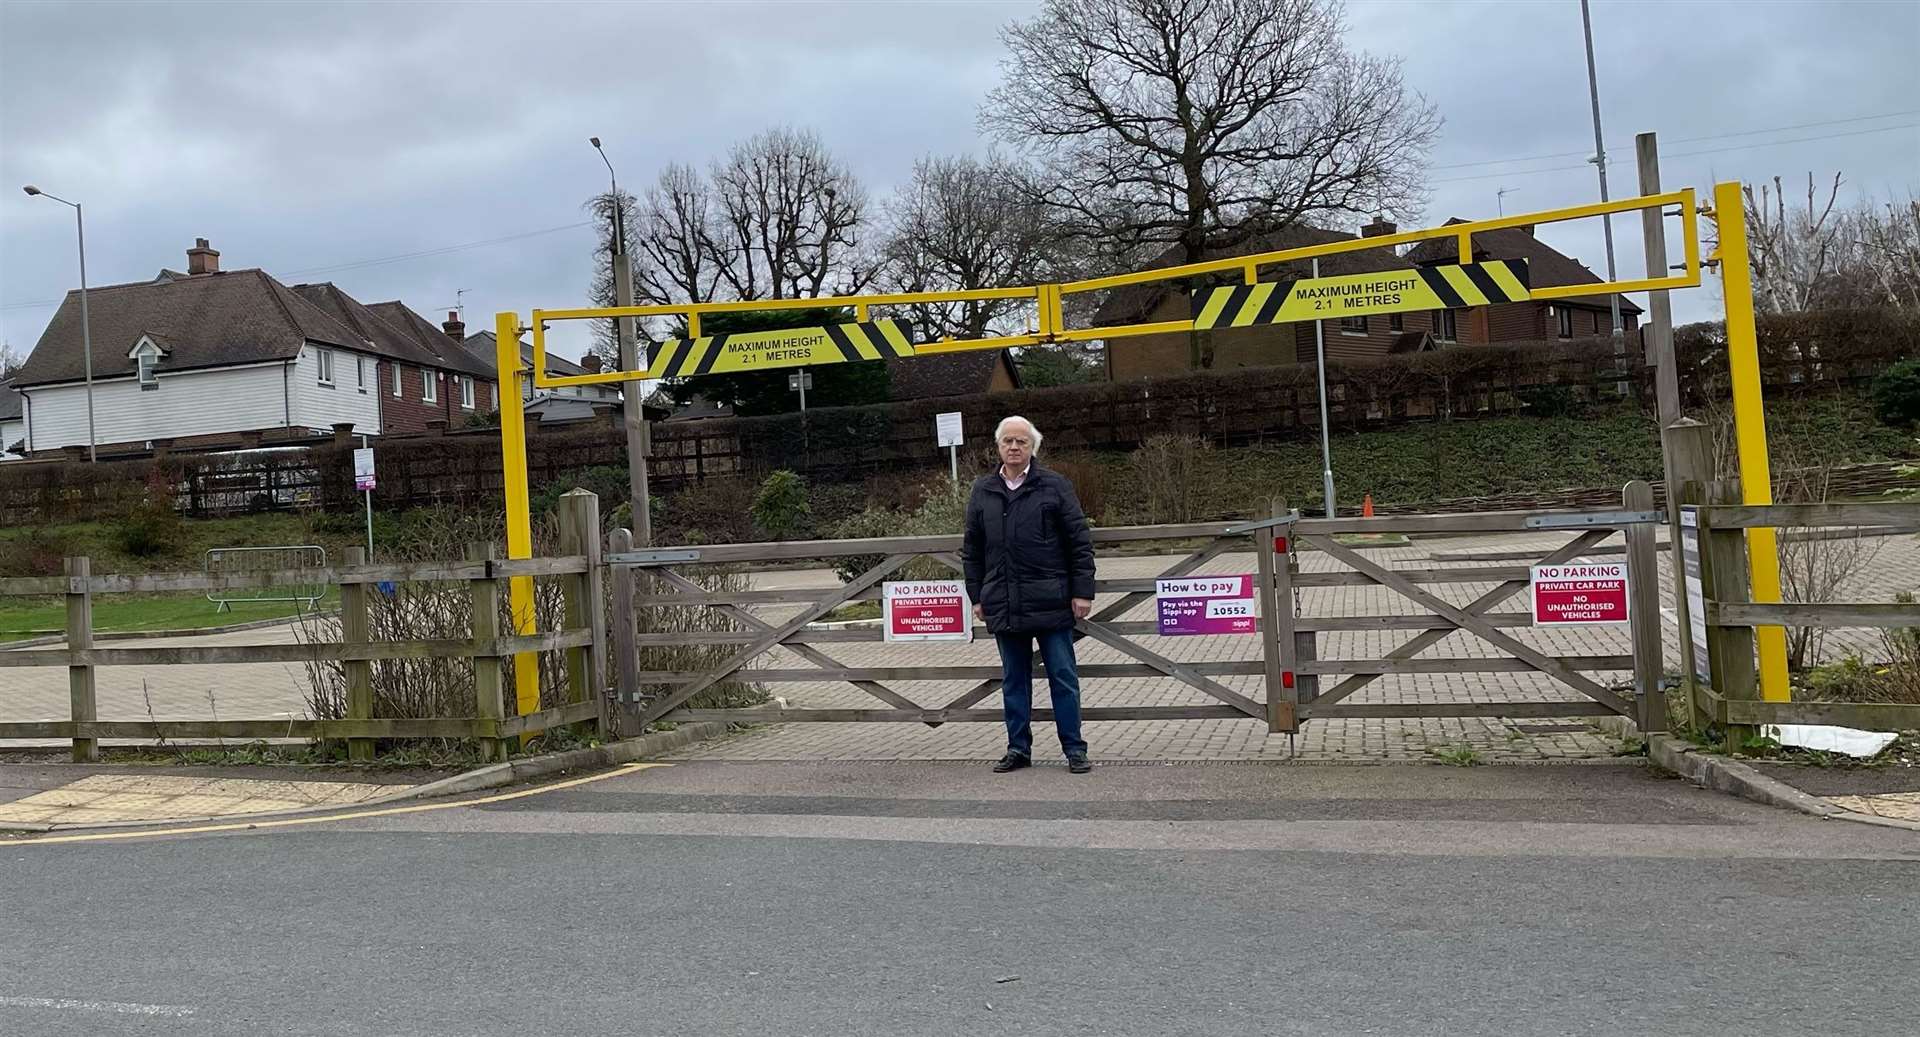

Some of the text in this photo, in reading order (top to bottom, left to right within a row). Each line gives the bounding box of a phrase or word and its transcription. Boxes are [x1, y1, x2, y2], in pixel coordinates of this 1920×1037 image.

[1296, 279, 1417, 299] MAXIMUM HEIGHT
[1315, 293, 1401, 310] 2.1 METRES
[728, 335, 824, 353] MAXIMUM HEIGHT
[742, 348, 811, 363] 2.1 METRES
[1540, 566, 1620, 577] NO PARKING
[894, 584, 958, 595] NO PARKING
[1161, 582, 1233, 593] How to pay
[1540, 582, 1573, 590] PRIVATE
[1596, 581, 1620, 589] PARK
[894, 598, 922, 606] PRIVATE
[939, 597, 958, 605] PARK
[1573, 595, 1587, 603] NO
[1213, 606, 1247, 615] 10552
[1547, 602, 1615, 611] UNAUTHORISED
[1163, 608, 1182, 616] Sippi
[1562, 611, 1601, 619] VEHICLES
[900, 616, 954, 625] UNAUTHORISED
